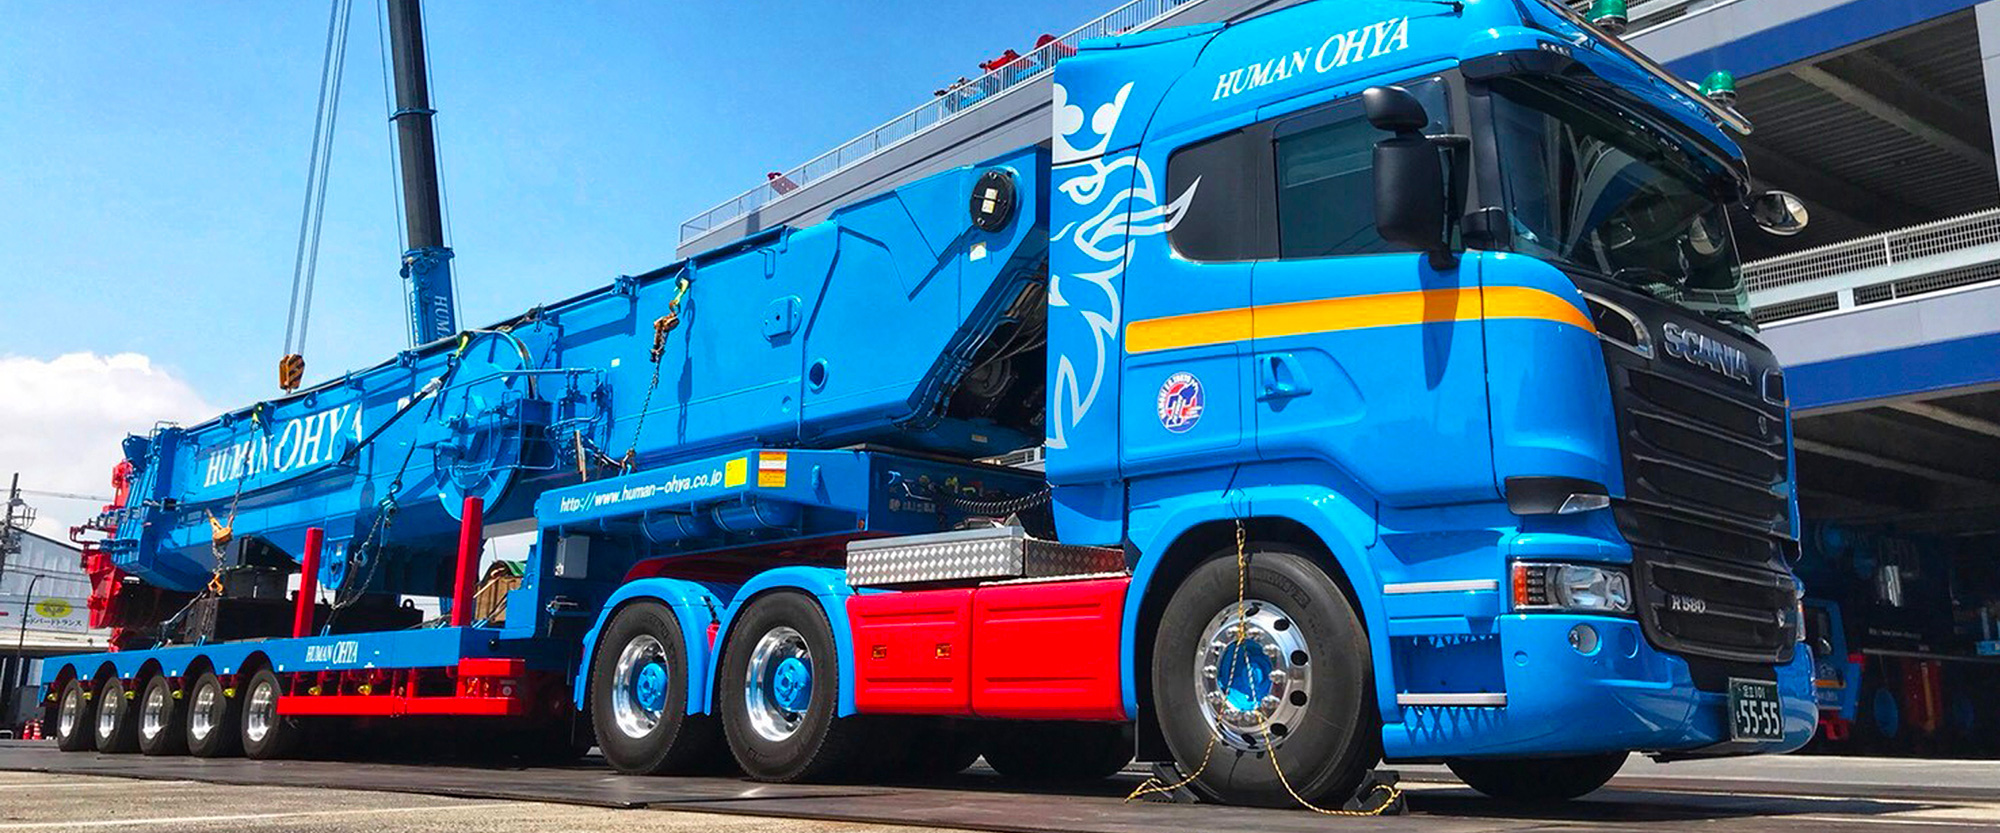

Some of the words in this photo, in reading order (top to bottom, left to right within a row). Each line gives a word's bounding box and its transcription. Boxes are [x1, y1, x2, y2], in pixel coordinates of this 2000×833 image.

[1212, 47, 1312, 101] HUMAN
[1314, 15, 1409, 73] OHYA
[1663, 322, 1752, 386] SCANIA
[1682, 596, 1706, 613] 580
[305, 644, 334, 663] HUMAN
[332, 640, 359, 664] OHYA
[1740, 699, 1780, 735] 55-55
